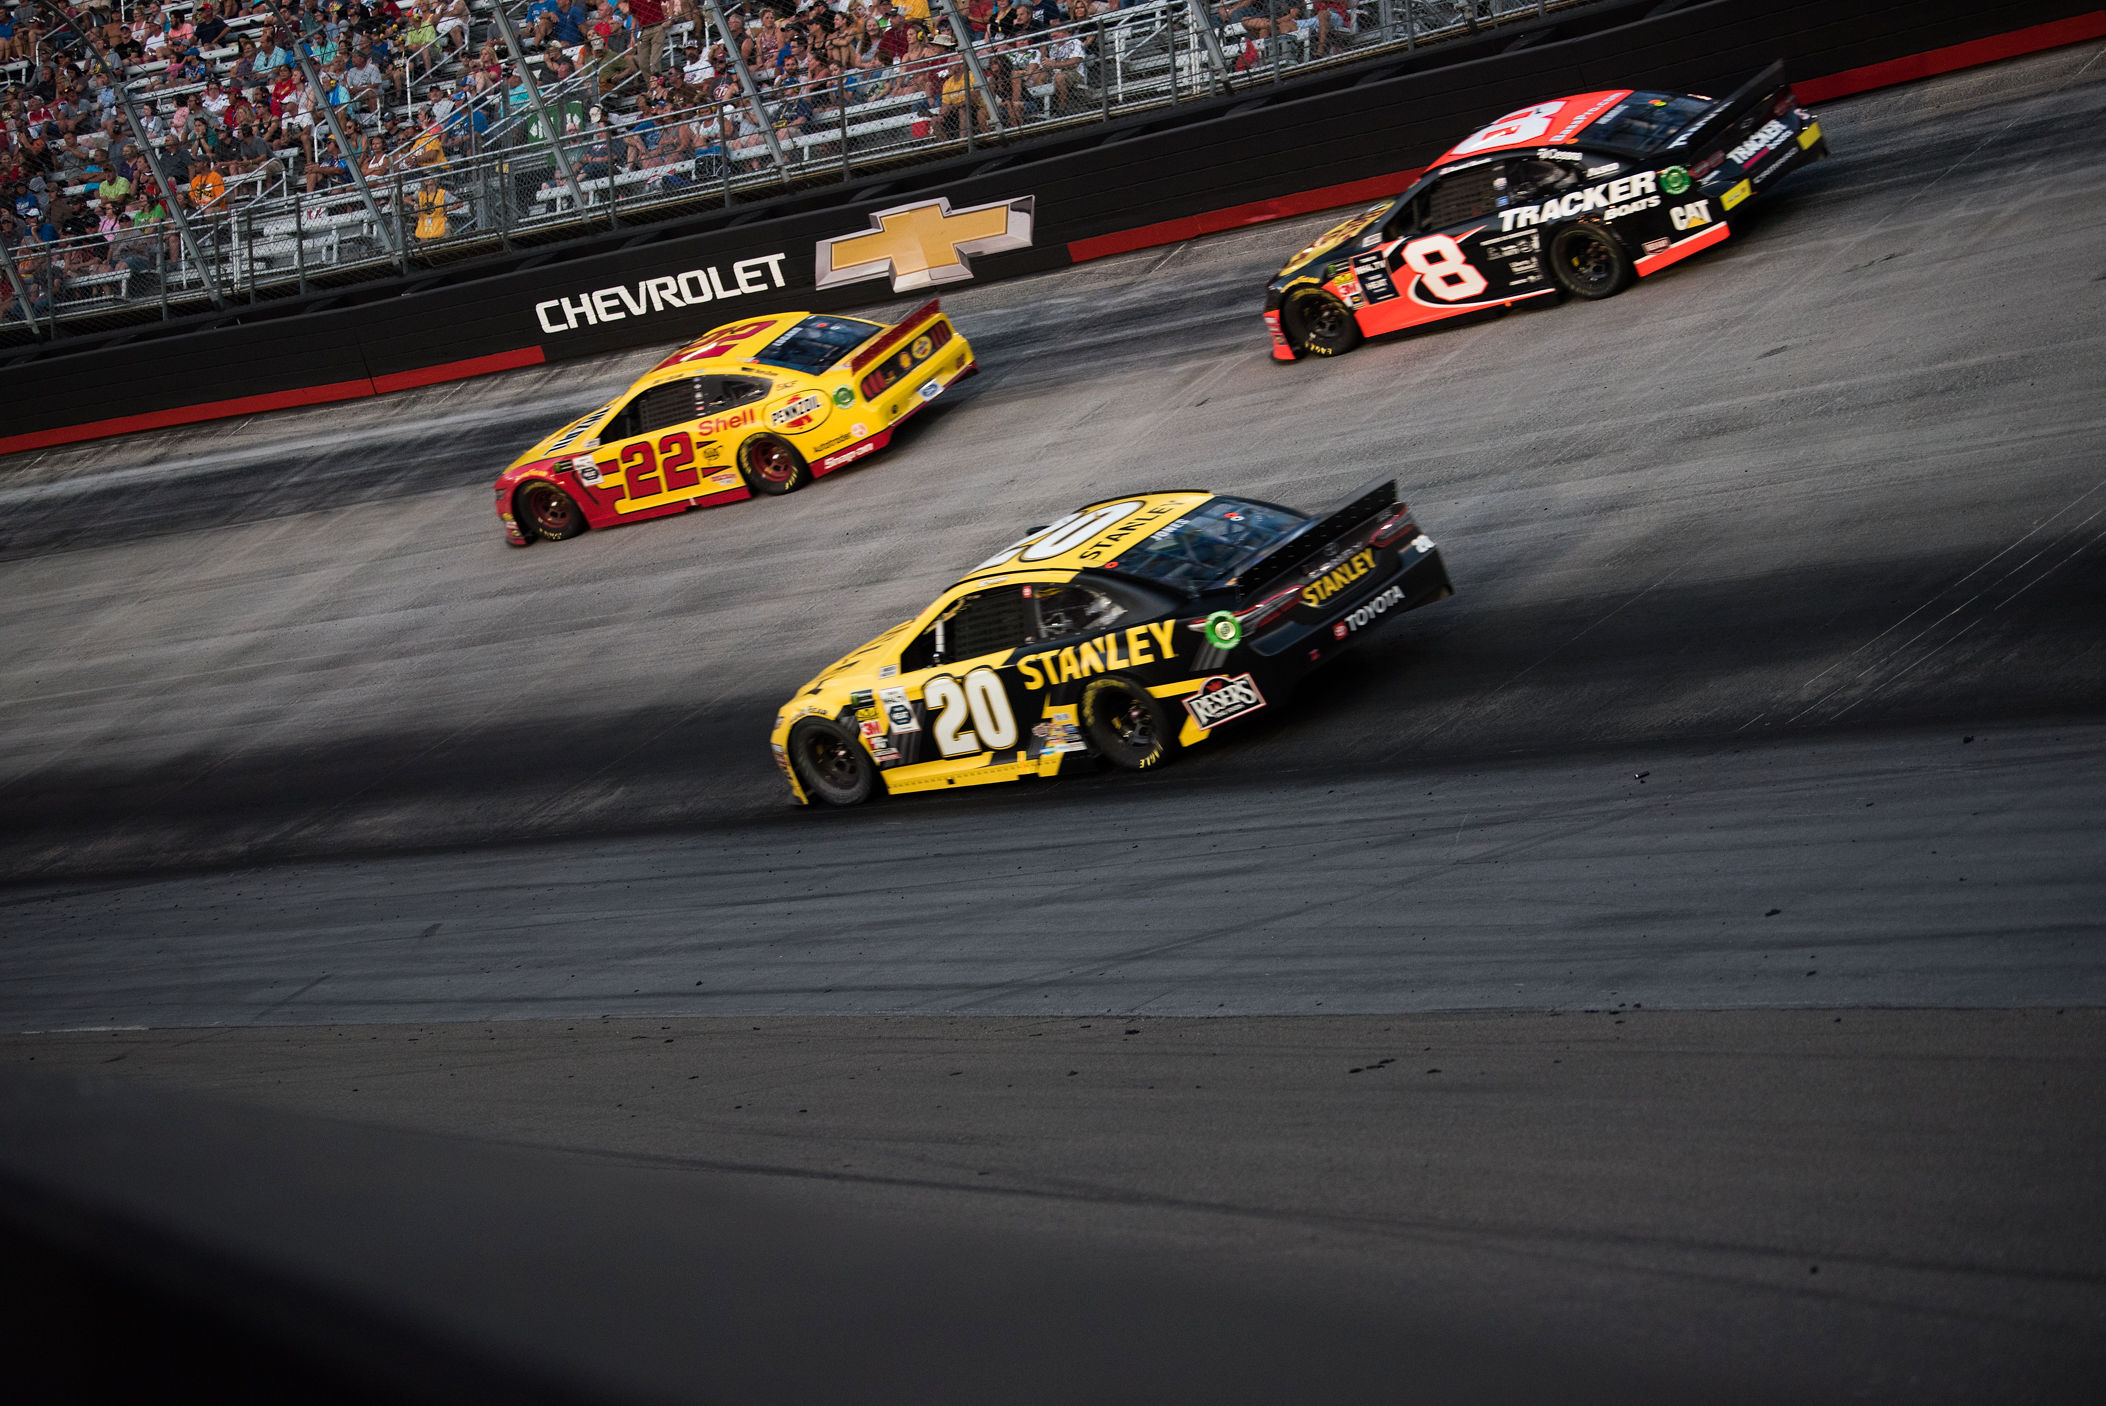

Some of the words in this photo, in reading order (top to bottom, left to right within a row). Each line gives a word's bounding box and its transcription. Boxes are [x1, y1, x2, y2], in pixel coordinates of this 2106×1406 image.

[1498, 170, 1656, 232] TRACKER
[1604, 195, 1662, 221] BOATS
[1669, 199, 1713, 231] CAT
[536, 253, 786, 333] CHEVROLET
[1401, 233, 1489, 301] 8
[698, 408, 755, 436] Shell
[621, 431, 700, 500] 22
[1080, 500, 1187, 561] STANLEY
[1151, 518, 1190, 541] JONES
[1302, 548, 1376, 606] STANLEY
[1344, 585, 1406, 631] TOYOTA
[1017, 619, 1179, 691] STANLEY
[922, 666, 1018, 757] 20
